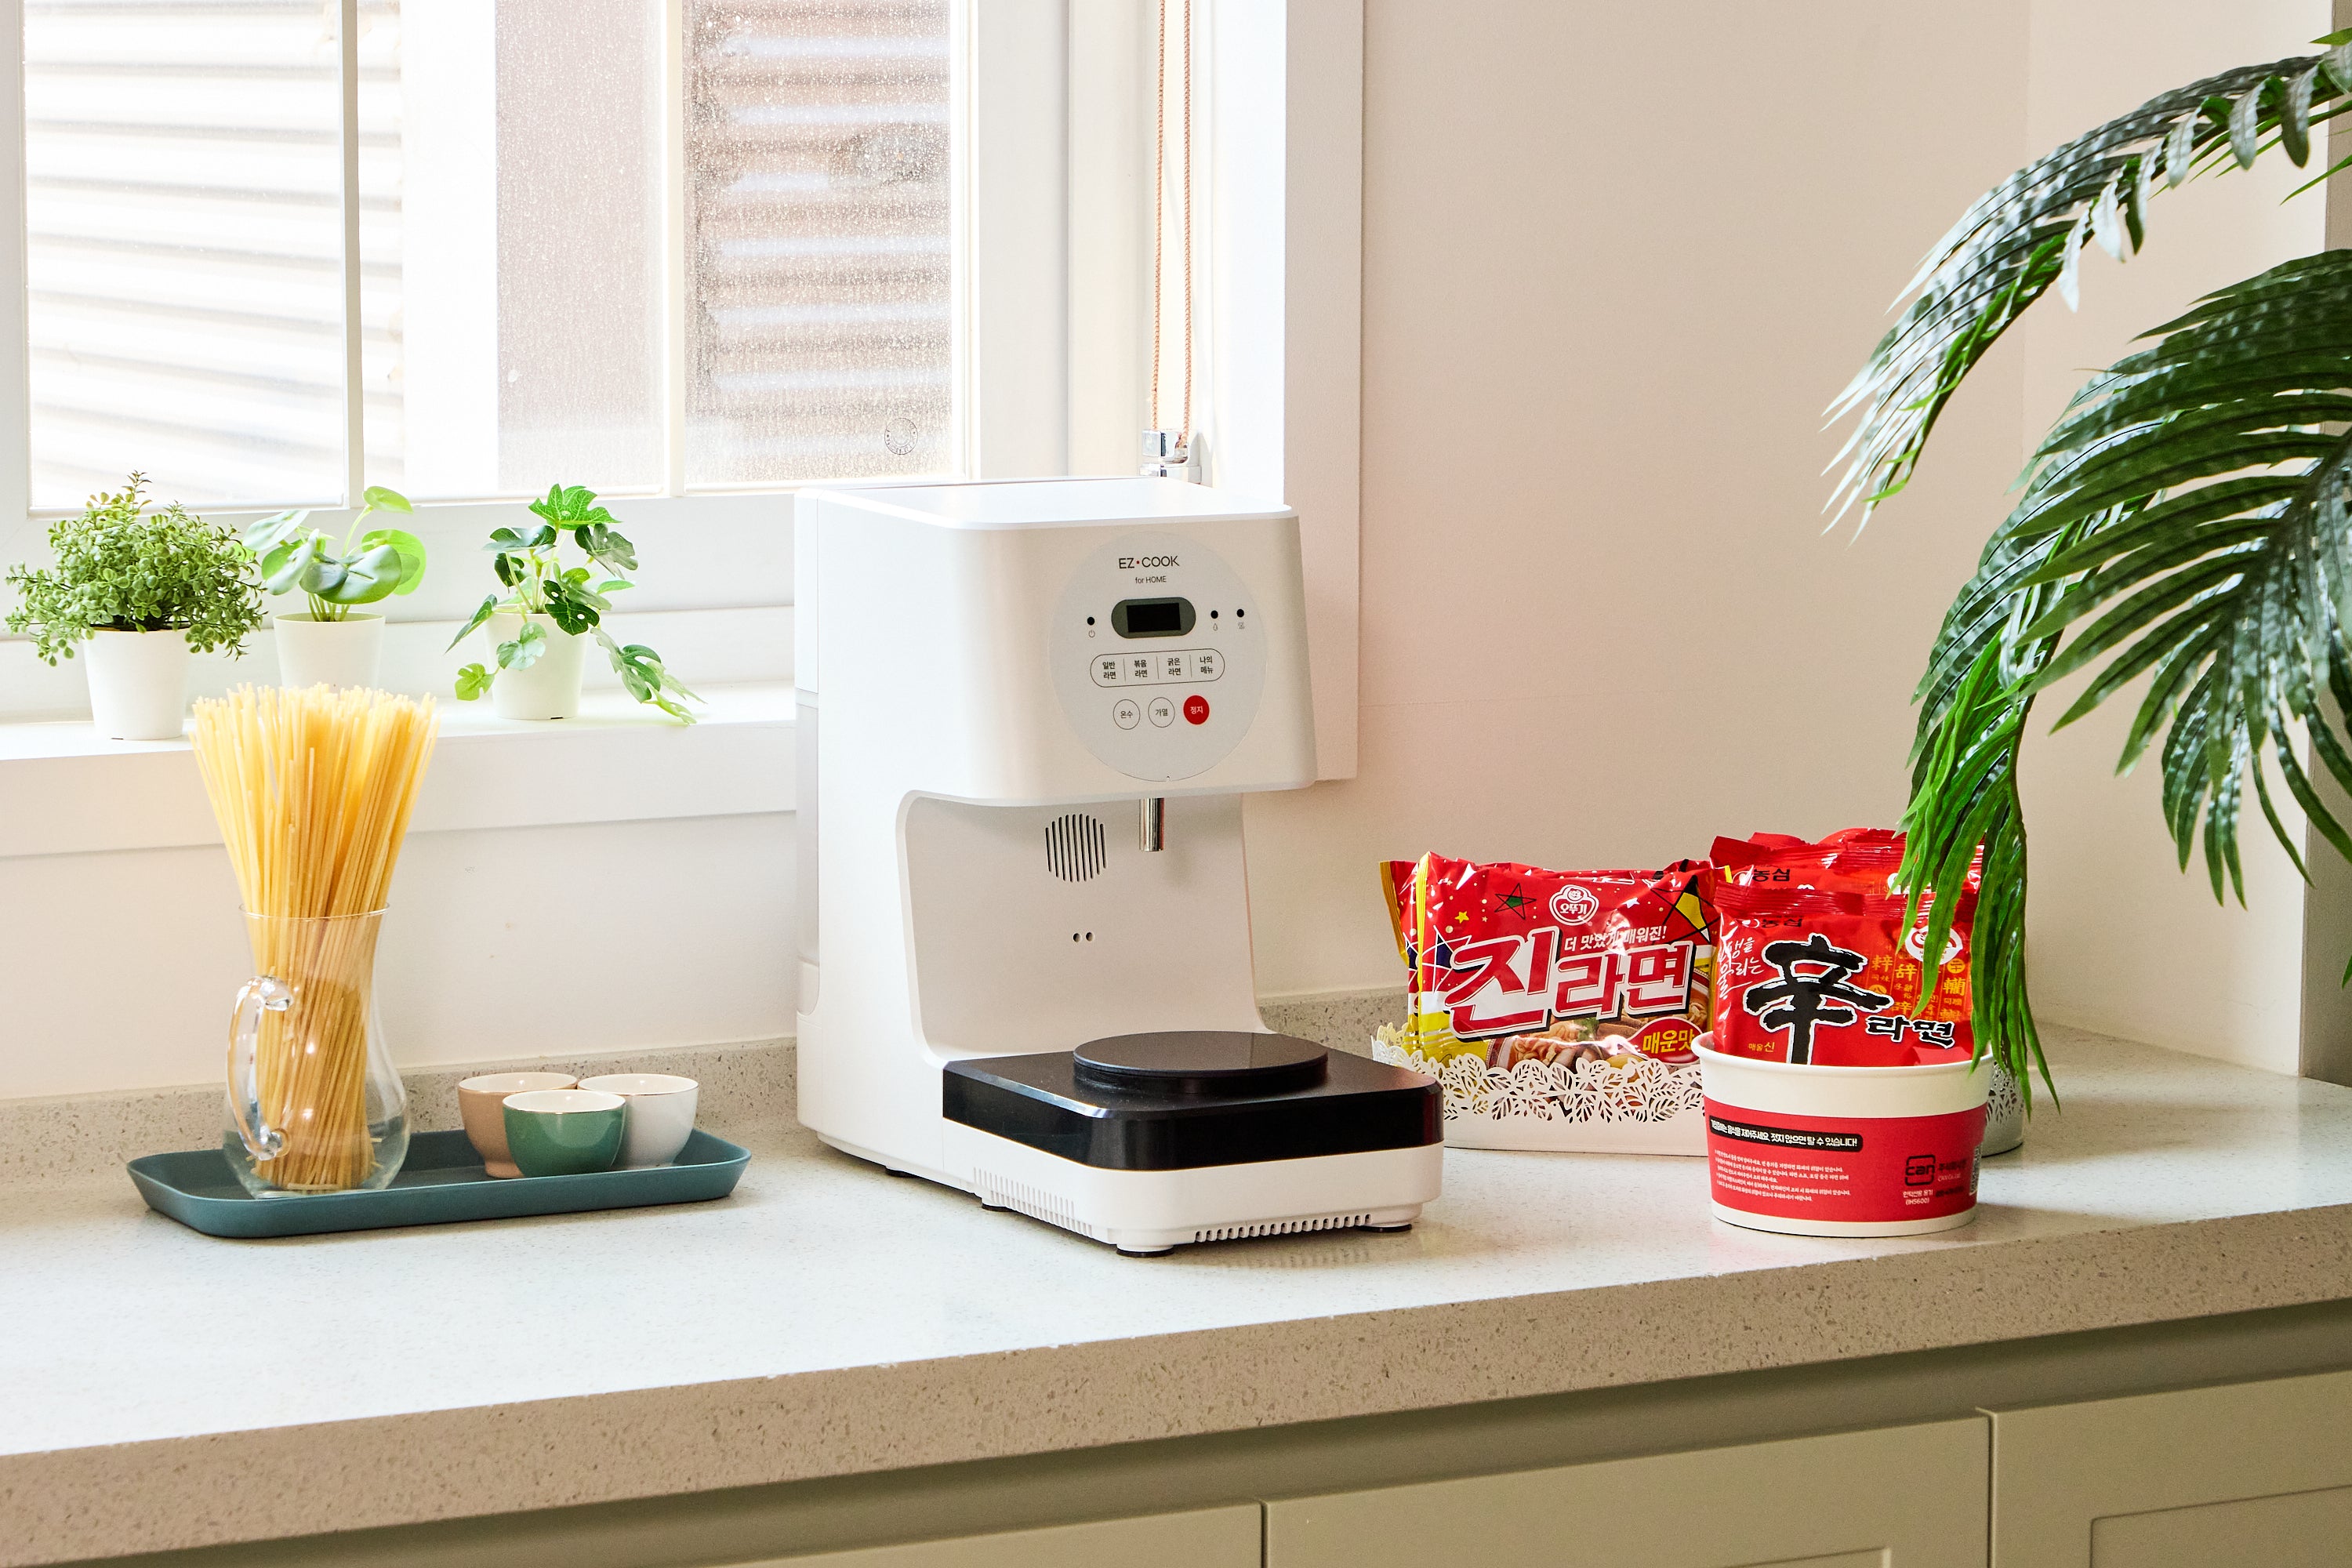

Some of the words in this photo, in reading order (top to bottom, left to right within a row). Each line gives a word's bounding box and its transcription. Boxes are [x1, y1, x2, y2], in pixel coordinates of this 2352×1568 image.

[1134, 659, 1147, 668] 볶음
[1167, 657, 1181, 666] 굵은
[1200, 655, 1213, 664] 나의
[1102, 661, 1116, 670] 일반
[1200, 666, 1214, 674] 메뉴
[1103, 671, 1116, 680] 라면
[1134, 670, 1148, 678] 라면
[1168, 667, 1181, 676] 라면
[1120, 710, 1133, 719] 온수
[1155, 708, 1168, 717] 가열
[1189, 706, 1203, 715] 정지
[1752, 868, 1791, 882] 농심
[1559, 902, 1588, 914] 오뚜기
[1564, 936, 1577, 952] 더
[1444, 926, 1696, 1041] 진라면
[1743, 933, 1894, 1065] 辛
[1865, 1015, 1955, 1049] 라면
[1642, 1028, 1695, 1054] 매운맛
[1785, 1134, 1807, 1145] 않으면
[1807, 1137, 1815, 1146] 탈
[1817, 1137, 1824, 1146] 수
[1825, 1137, 1858, 1147] 있습니다!
[1905, 1164, 1935, 1176] can
